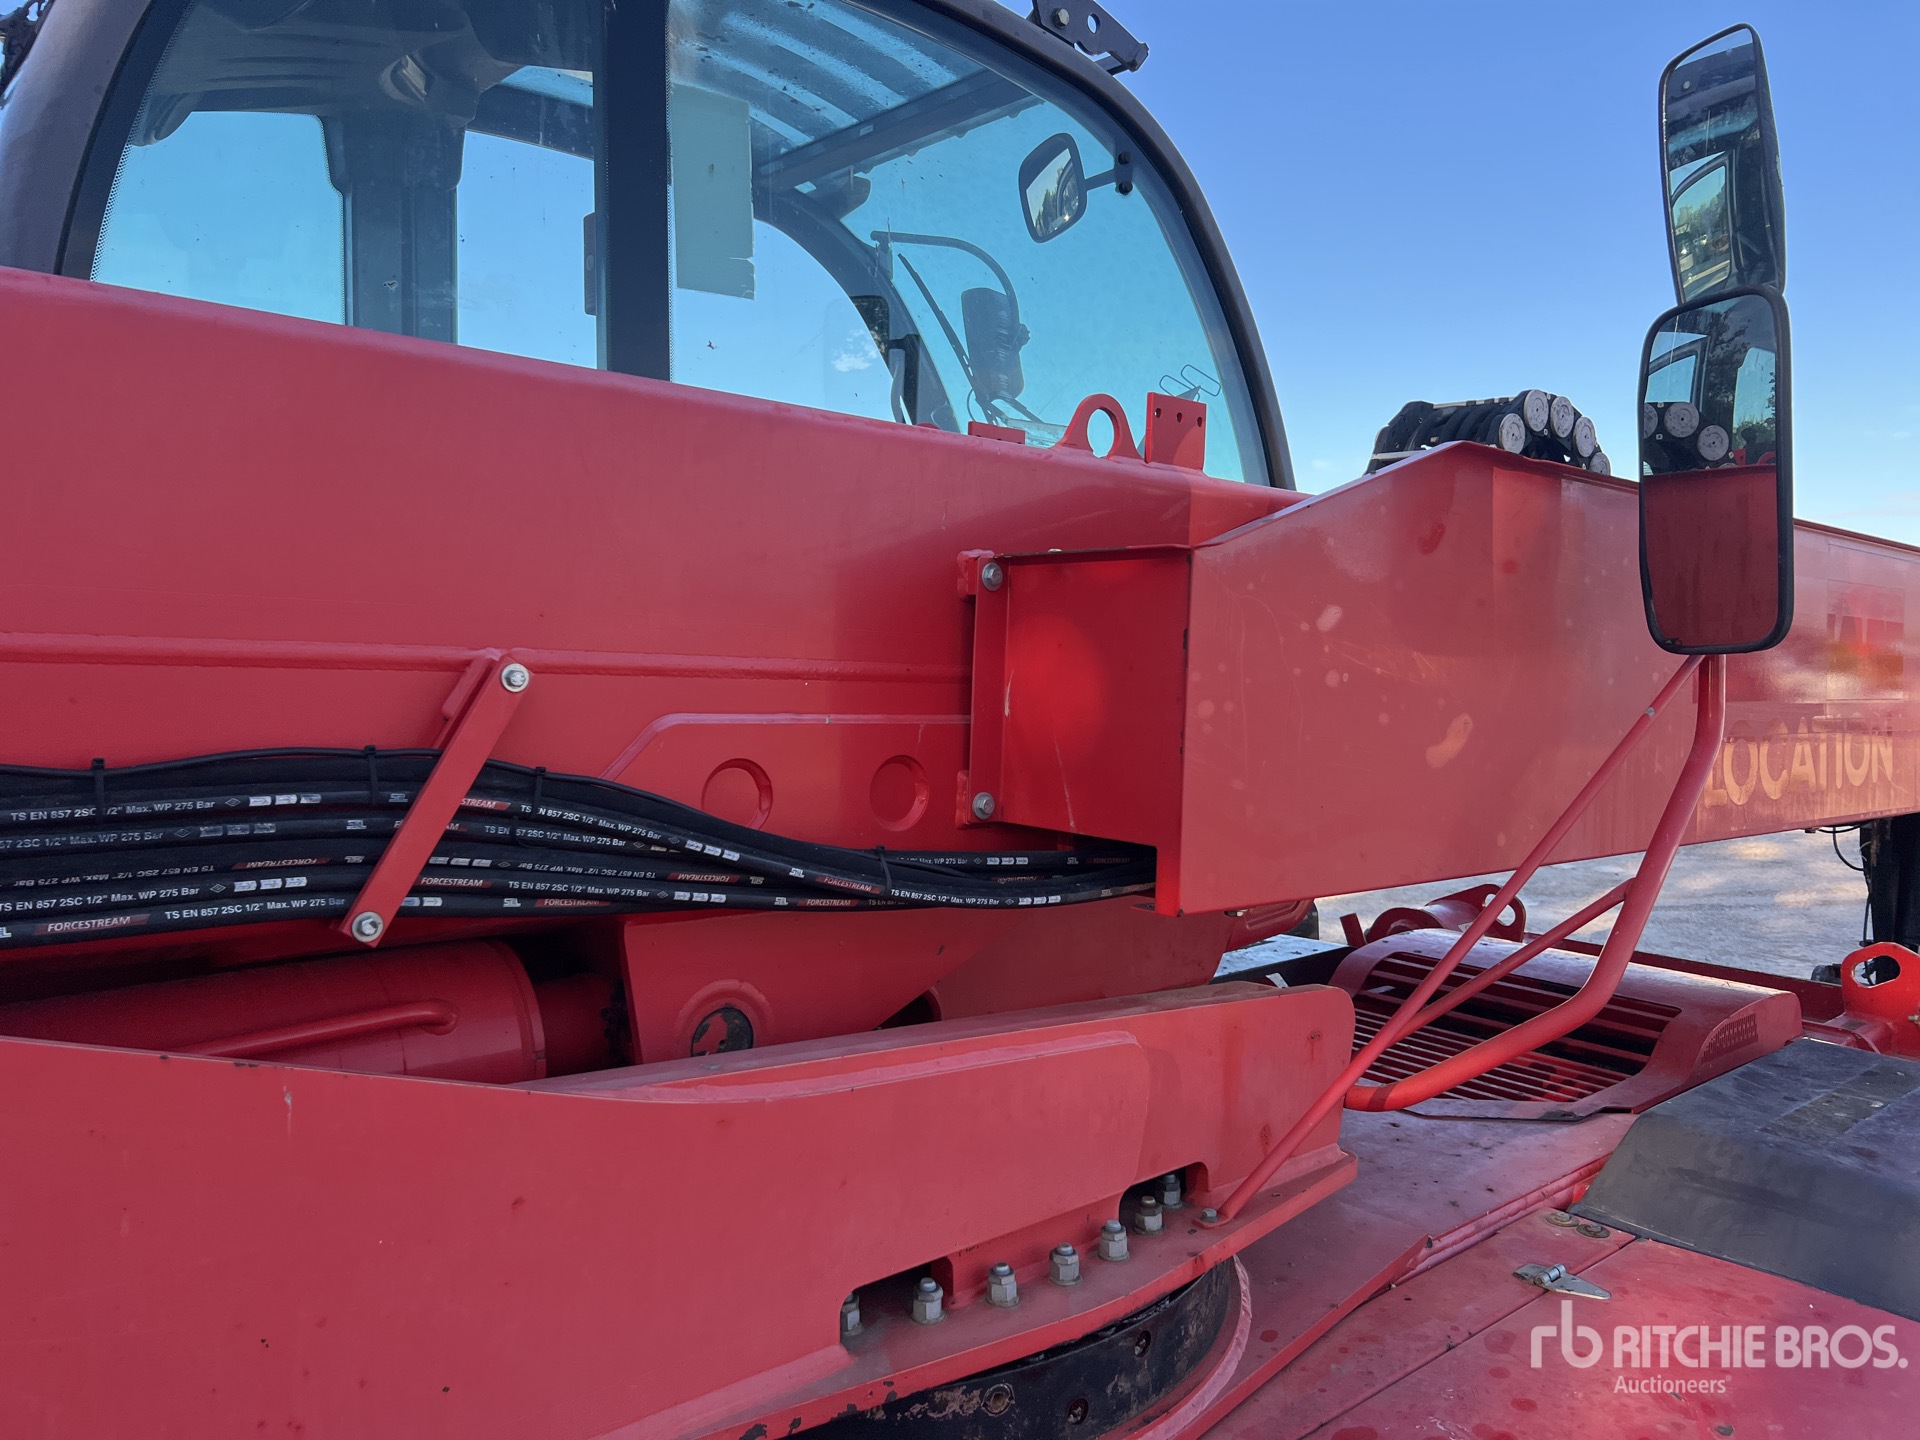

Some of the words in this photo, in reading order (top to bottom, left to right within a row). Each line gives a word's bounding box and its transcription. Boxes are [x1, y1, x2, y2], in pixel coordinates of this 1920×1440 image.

[11, 812, 27, 821] TS
[30, 811, 47, 820] EN
[50, 810, 71, 819] 857
[74, 808, 97, 818] 2SC
[154, 803, 172, 812] WP
[174, 802, 194, 811] 275
[196, 801, 216, 809] Bar
[461, 798, 496, 809] STREAM
[520, 804, 532, 813] TS
[547, 809, 562, 819] 857
[563, 812, 581, 822] 2SC
[618, 823, 632, 833] WP
[632, 827, 647, 837] 275
[647, 831, 661, 840] Bar
[16, 838, 41, 848] 2SC
[98, 833, 118, 843] WP
[121, 832, 141, 841] 275
[144, 831, 164, 840] Bar
[484, 825, 496, 833] TS
[497, 826, 510, 835] EN
[527, 830, 545, 839] 2SC
[582, 835, 596, 844] WP
[597, 837, 611, 846] 275
[612, 839, 626, 847] Bar
[246, 858, 317, 869] FORCESTREAM
[518, 862, 533, 870] Bar
[534, 863, 548, 871] 275
[550, 864, 563, 872] WP
[183, 866, 199, 874] EN
[200, 865, 215, 873] TS
[61, 876, 81, 884] WP
[633, 871, 646, 879] EN
[677, 873, 730, 883] FORCESTREAM
[13, 879, 35, 887] Bar
[38, 877, 58, 886] 275
[421, 876, 484, 888] FORCESTREAM
[508, 881, 520, 889] TS
[521, 881, 534, 890] EN
[535, 882, 550, 890] 857
[551, 883, 569, 892] 2SC
[606, 887, 620, 895] WP
[621, 889, 635, 897] 275
[636, 890, 650, 898] Bar
[806, 898, 851, 907] FORCESTREAM
[824, 876, 873, 892] FORCESTREAM
[891, 888, 900, 896] TS
[900, 890, 911, 898] EN
[911, 891, 922, 900] 857
[923, 893, 936, 902] 2SC
[966, 897, 976, 905] WP
[977, 898, 988, 906] 275
[988, 898, 1000, 906] Bar
[16, 901, 33, 911] EN
[36, 899, 57, 909] 857
[60, 897, 83, 907] 2SC
[138, 891, 157, 900] WP
[160, 889, 179, 898] 275
[181, 887, 200, 897] Bar
[47, 915, 132, 933] FORCESTREAM
[165, 911, 180, 920] TS
[182, 909, 198, 918] EN
[200, 907, 219, 917] 857
[221, 904, 243, 914] 2SC
[291, 899, 308, 908] WP
[309, 898, 326, 907] 275
[328, 898, 346, 906] Bar
